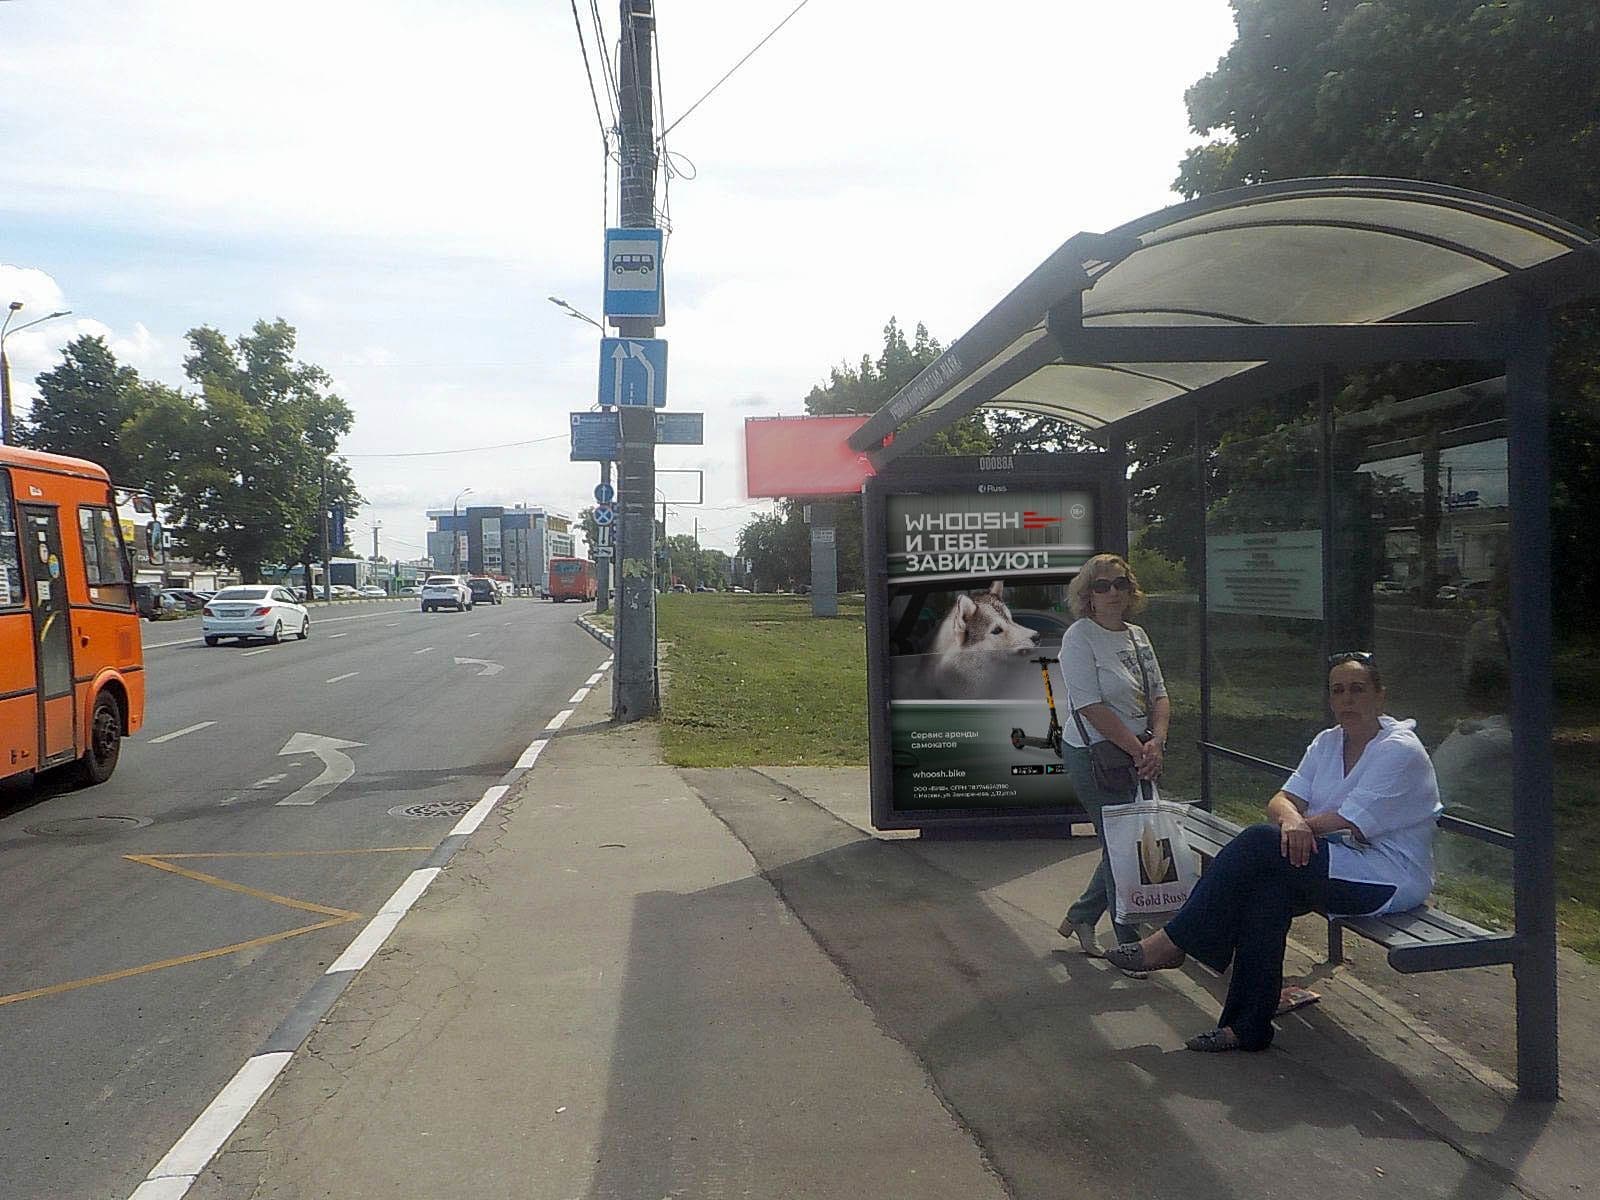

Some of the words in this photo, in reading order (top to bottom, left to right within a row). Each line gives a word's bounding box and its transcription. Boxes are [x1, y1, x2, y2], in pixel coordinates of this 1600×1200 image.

[905, 512, 1019, 531] WHOOSH
[905, 534, 922, 552] И
[929, 533, 989, 551] ТЕБЕ
[905, 551, 1049, 573] ЗАВИДУЮТ!
[911, 731, 943, 740] Сервис
[944, 731, 979, 739] аренды
[911, 741, 957, 749] самокатов
[912, 769, 966, 778] whoosh.bike
[1132, 891, 1161, 907] Gold
[1163, 893, 1187, 905] Rush
